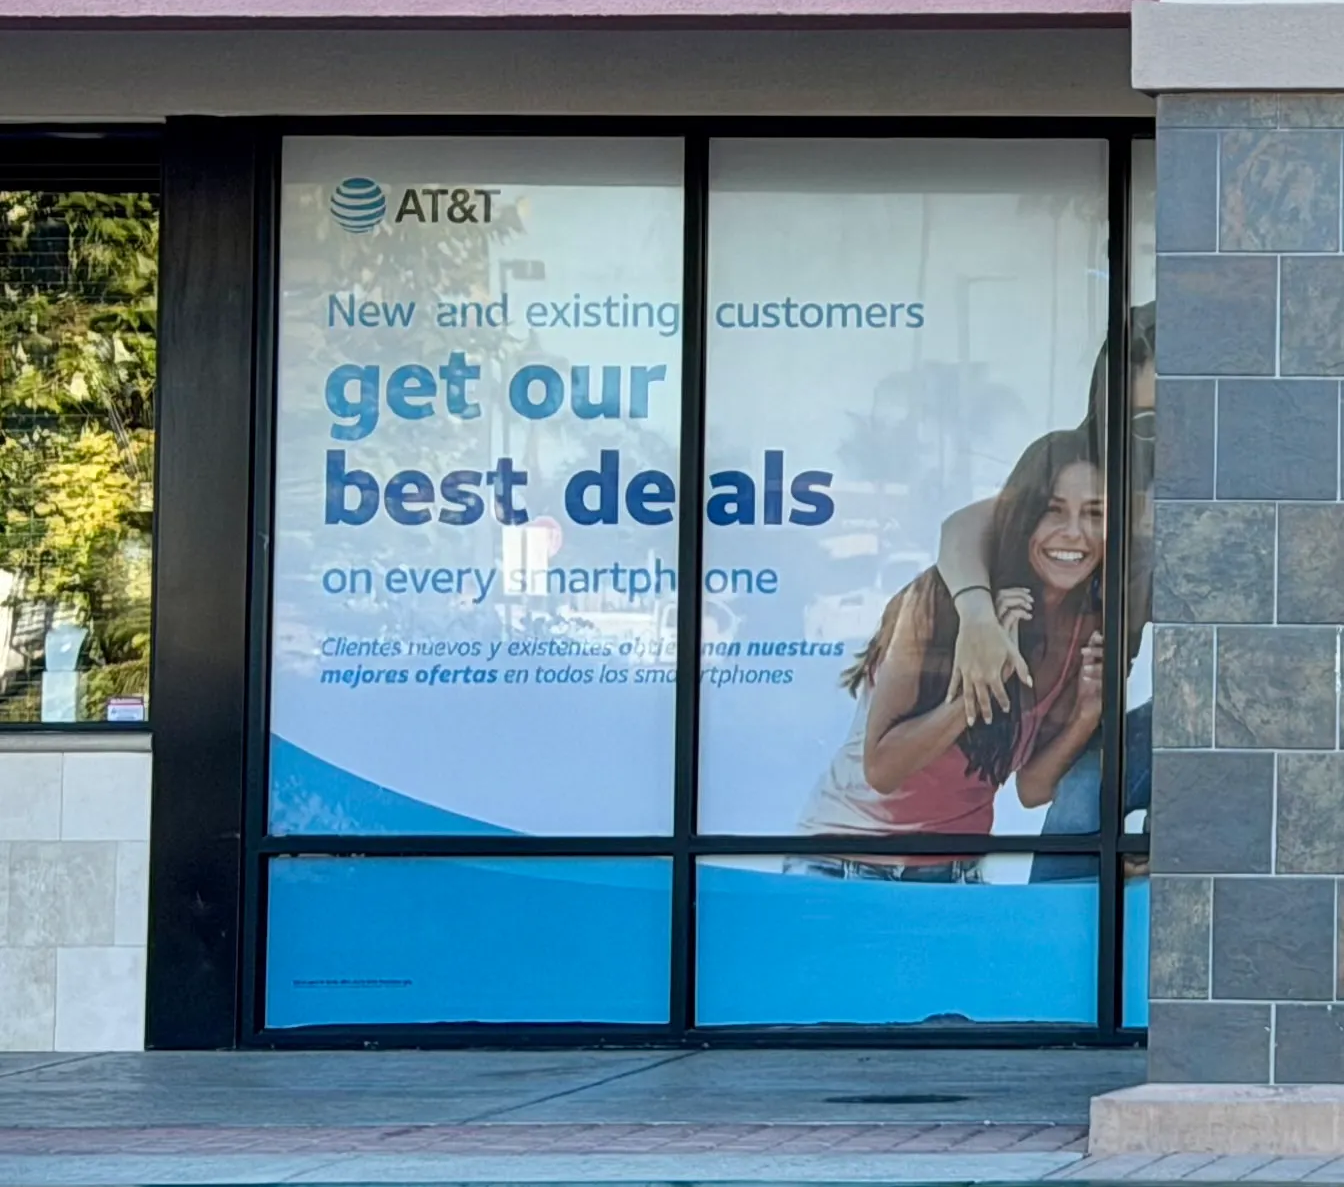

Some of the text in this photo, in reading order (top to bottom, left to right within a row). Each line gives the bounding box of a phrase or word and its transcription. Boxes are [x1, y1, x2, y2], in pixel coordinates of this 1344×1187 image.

[395, 188, 501, 224] AT&T
[328, 293, 925, 338] New and existing customers
[325, 350, 667, 441] get our
[325, 449, 529, 525] best
[322, 567, 372, 595] on
[385, 567, 497, 604] every
[321, 637, 401, 657] Clientes
[407, 640, 482, 657] nuevos
[486, 641, 502, 661] y
[507, 637, 612, 657] existentes
[746, 638, 845, 657] nuestras
[320, 665, 409, 688] mejores
[415, 664, 498, 686] ofertas
[503, 669, 529, 684] en
[535, 665, 594, 684] todos
[599, 664, 628, 684] los
